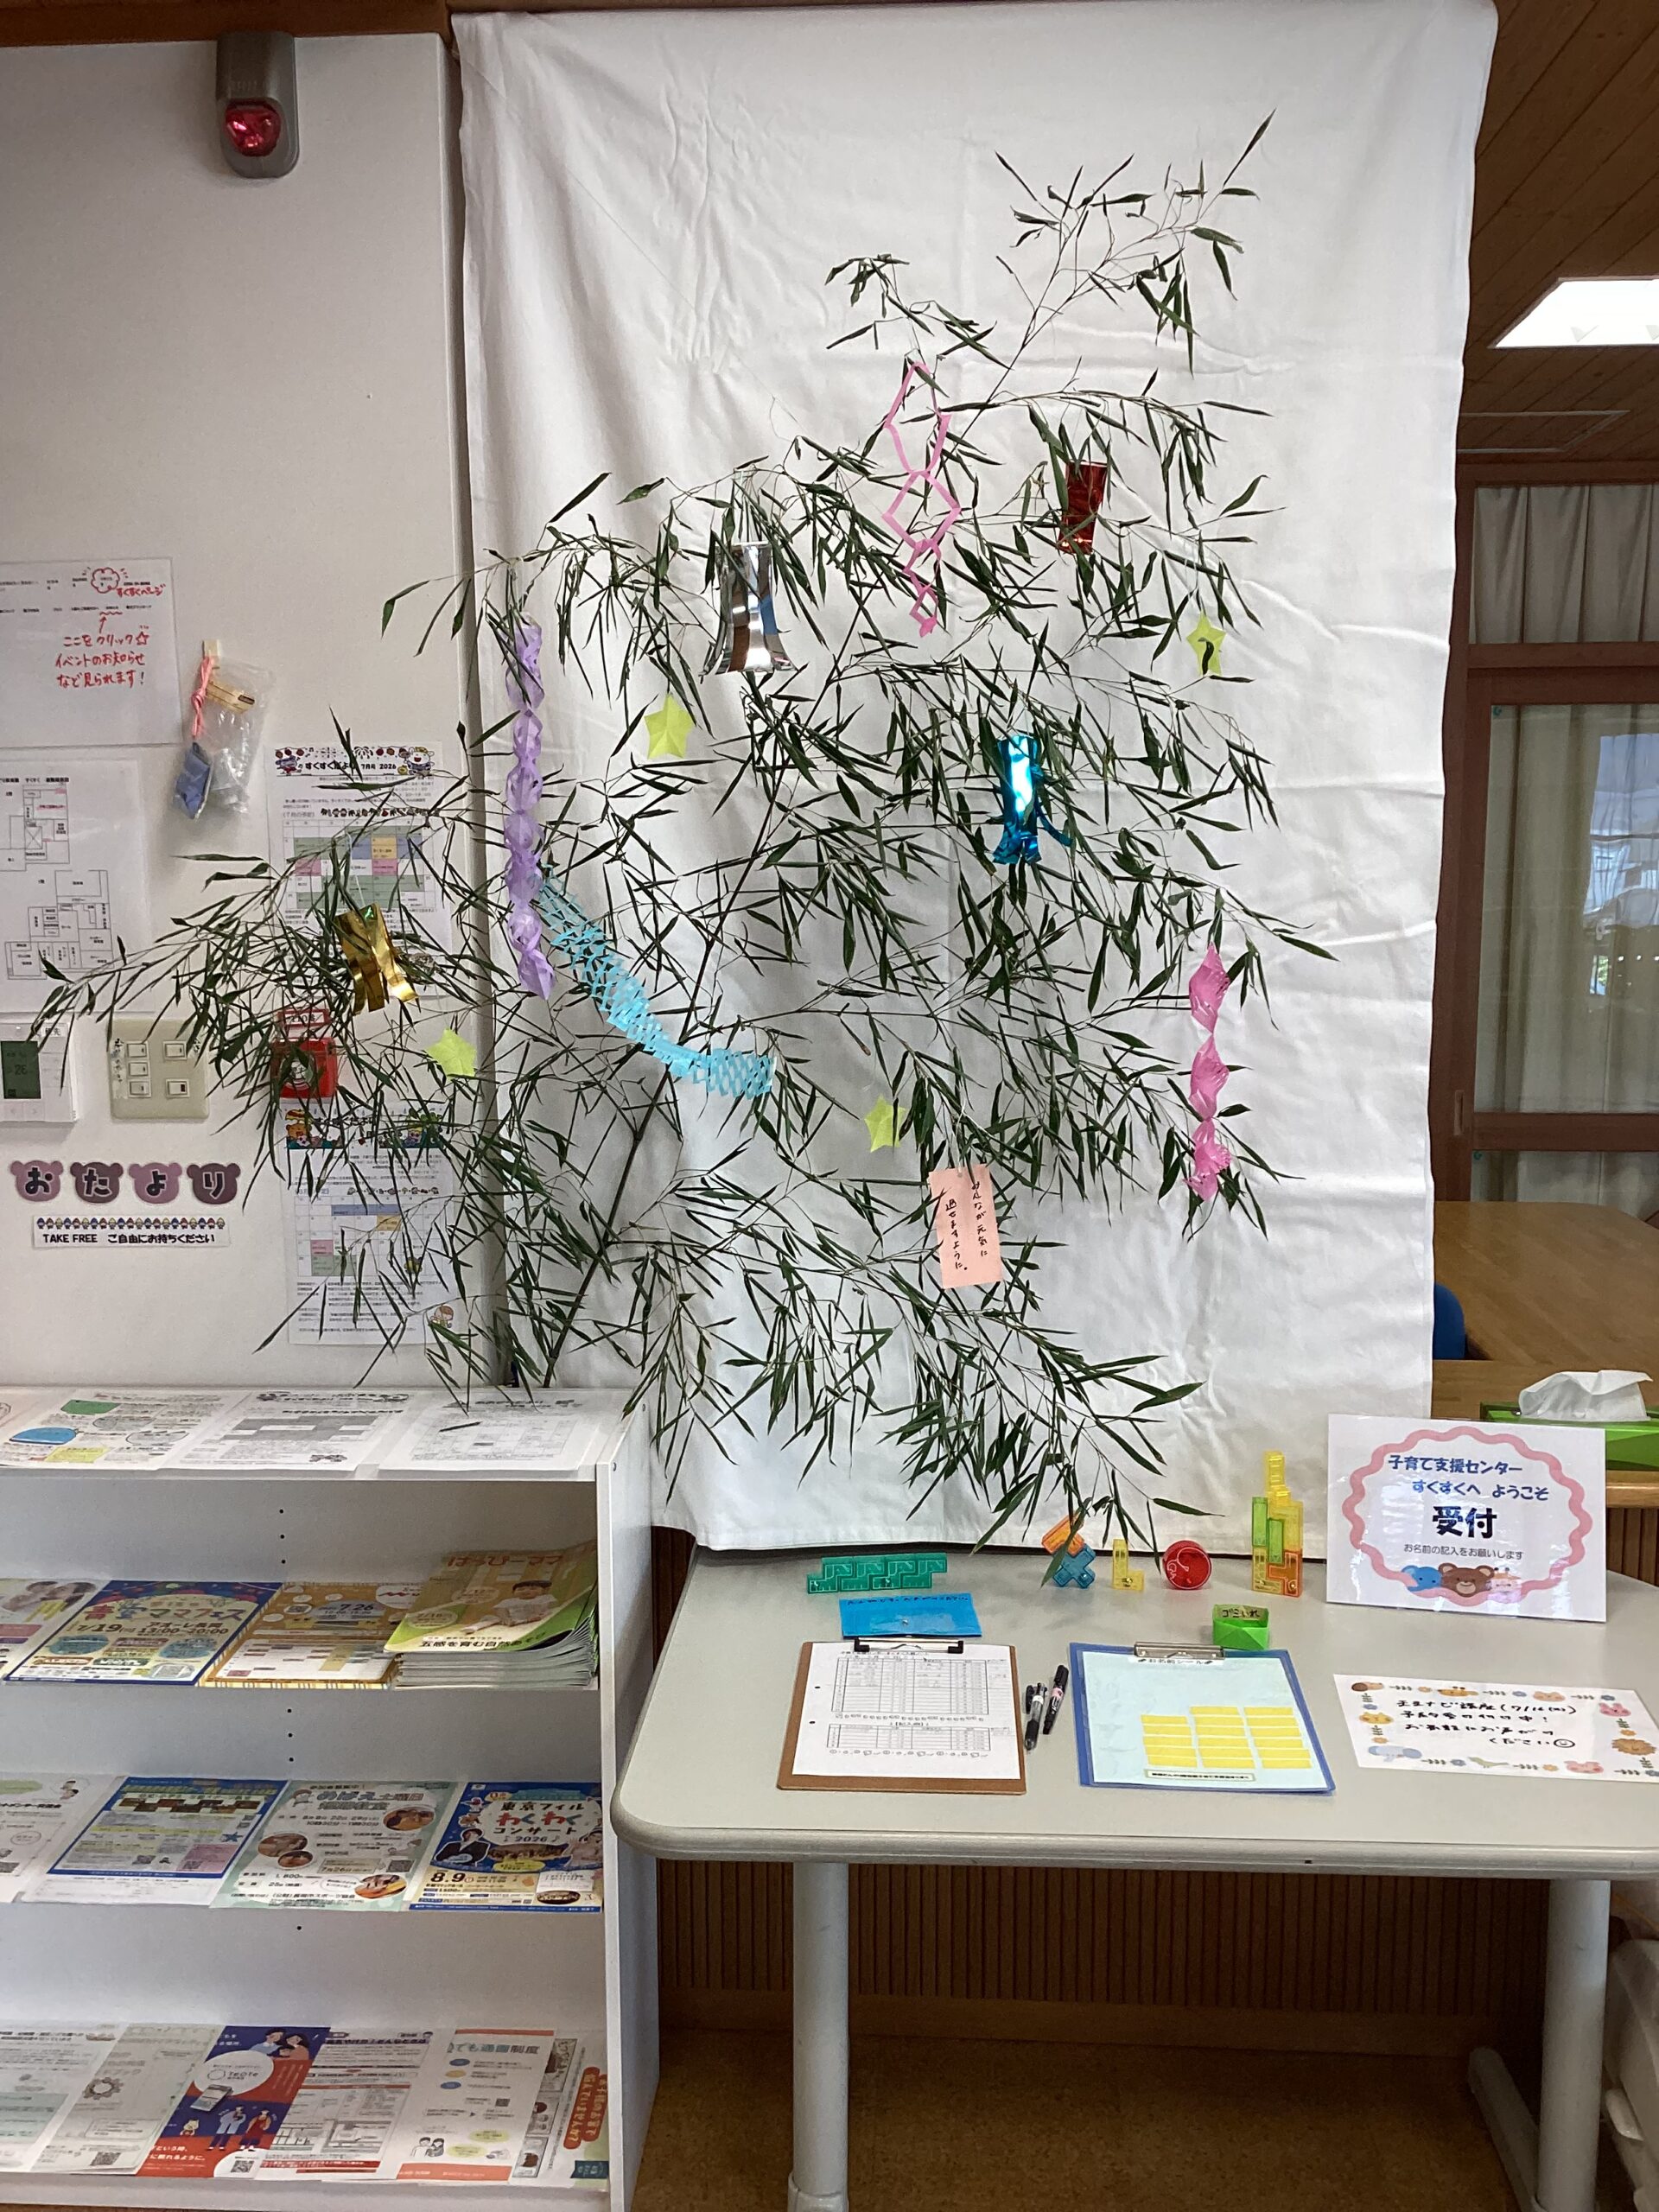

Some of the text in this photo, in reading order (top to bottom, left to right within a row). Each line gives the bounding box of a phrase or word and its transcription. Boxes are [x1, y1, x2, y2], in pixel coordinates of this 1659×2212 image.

[55, 651, 146, 668] イベントのお知らせ
[971, 1180, 988, 1258] みんなが元気に
[43, 1233, 98, 1243] TAKE FREE
[107, 1233, 215, 1244] ご自由にお持ちください
[1388, 1454, 1523, 1475] 子育て支援センター
[1412, 1479, 1549, 1502] すくすくへ ようこそ
[1432, 1504, 1497, 1539] 受付
[1403, 1543, 1524, 1560] お名前の記入をお願いします
[1222, 1608, 1262, 1618] ゴミいれ
[500, 1802, 585, 1811] 東京フィル
[496, 1810, 582, 1827] わくわく
